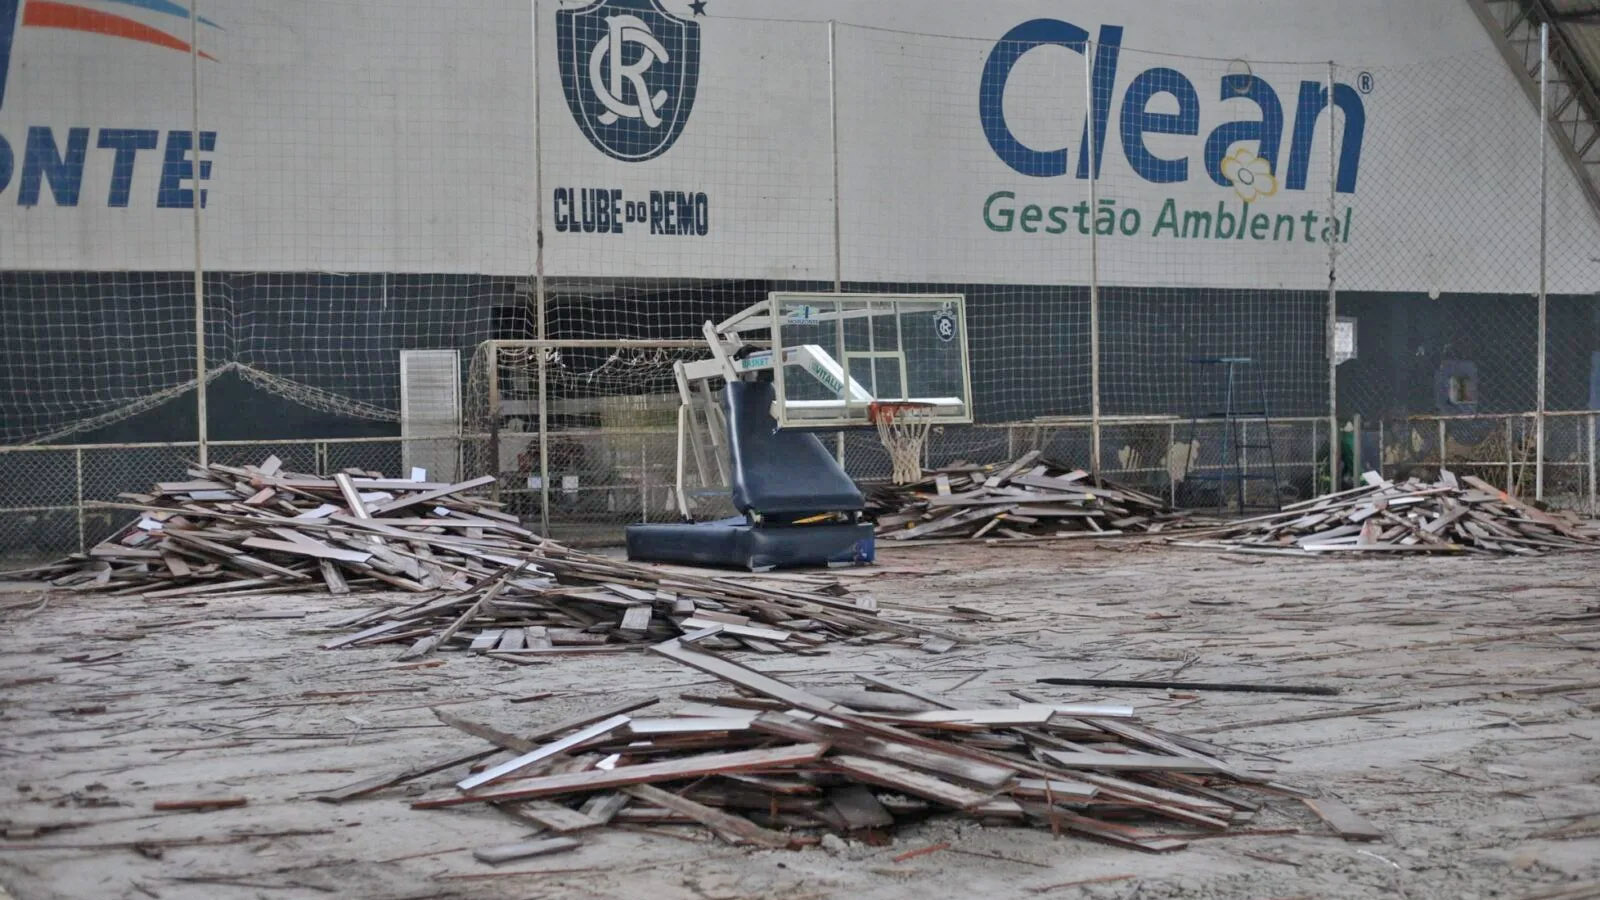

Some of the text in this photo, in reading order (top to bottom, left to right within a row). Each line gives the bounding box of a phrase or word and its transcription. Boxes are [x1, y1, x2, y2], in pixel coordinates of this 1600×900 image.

[979, 18, 1366, 194] Clean
[554, 187, 709, 236] CLUBE DO REMO
